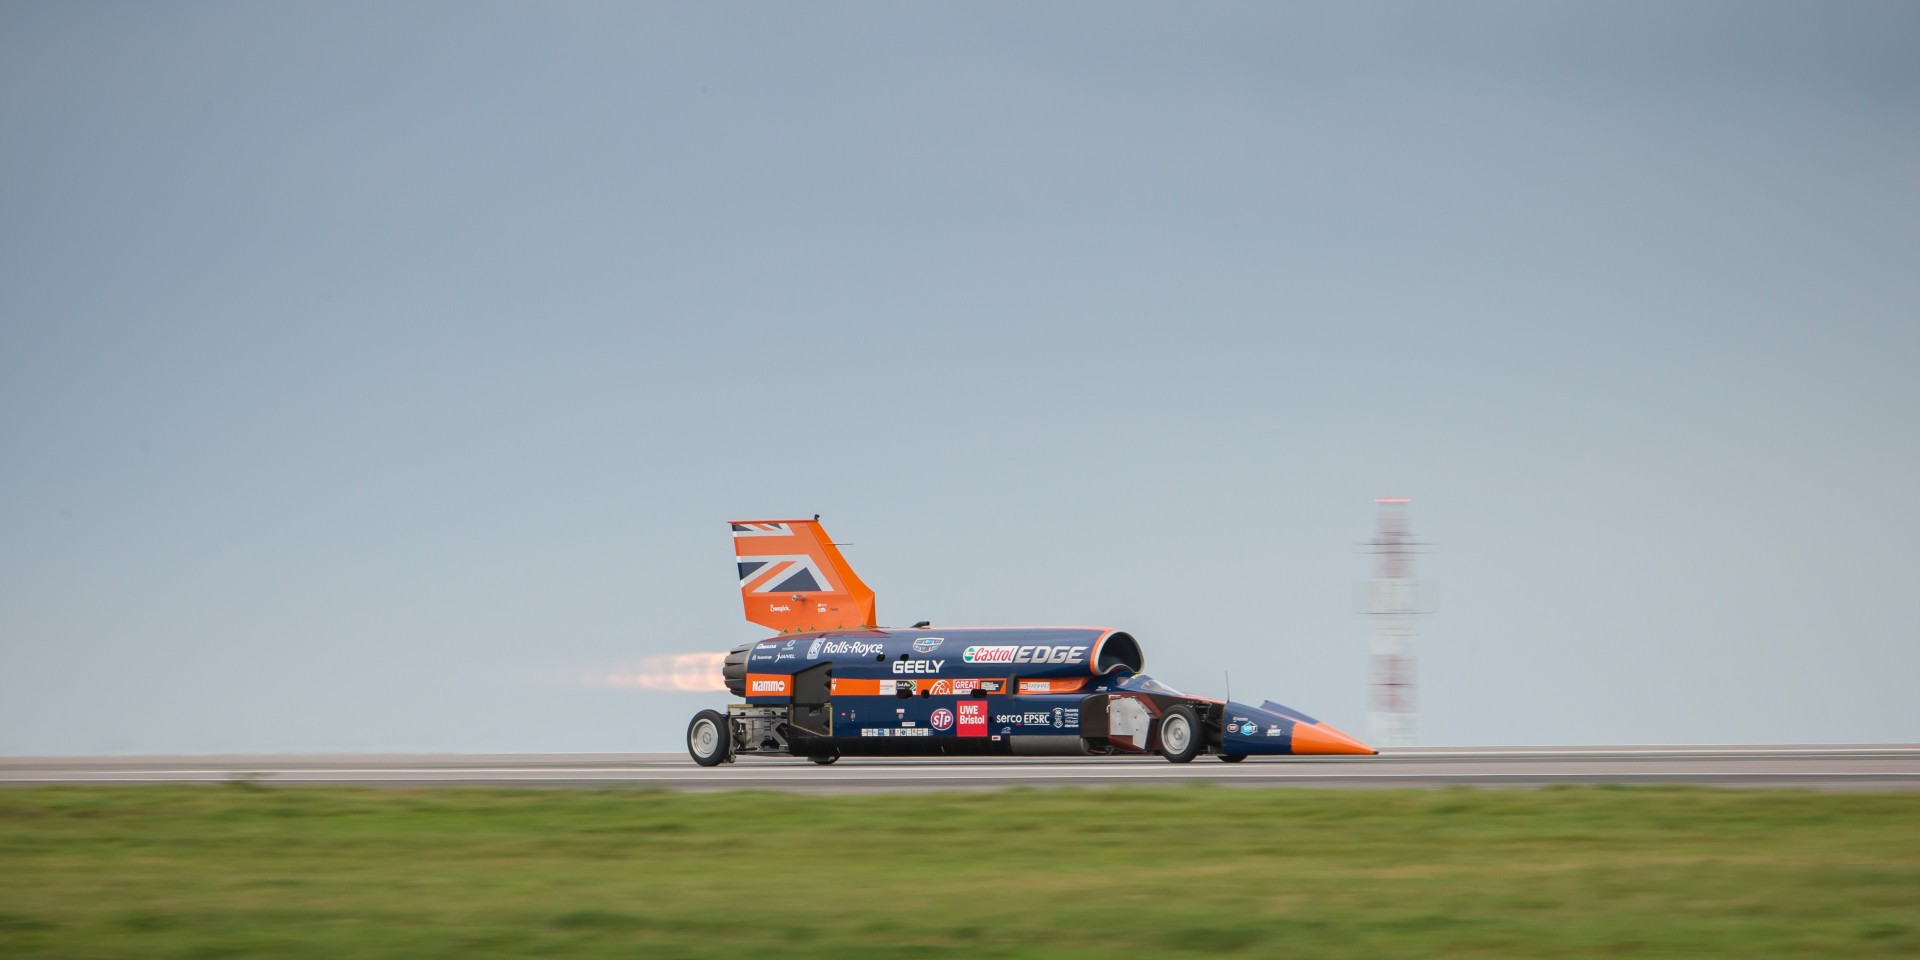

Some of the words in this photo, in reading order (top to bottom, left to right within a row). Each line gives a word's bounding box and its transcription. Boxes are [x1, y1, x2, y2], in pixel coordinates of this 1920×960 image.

[823, 641, 883, 657] Rolls-Royce
[974, 647, 1016, 662] Castrol
[1014, 646, 1089, 664] EDGE
[892, 660, 945, 674] GEELY
[955, 680, 977, 689] GREAT
[960, 705, 978, 714] UWE
[933, 711, 951, 728] STP
[960, 715, 985, 725] Bristol
[996, 714, 1022, 723] serco
[1024, 714, 1050, 724] EPSRC
